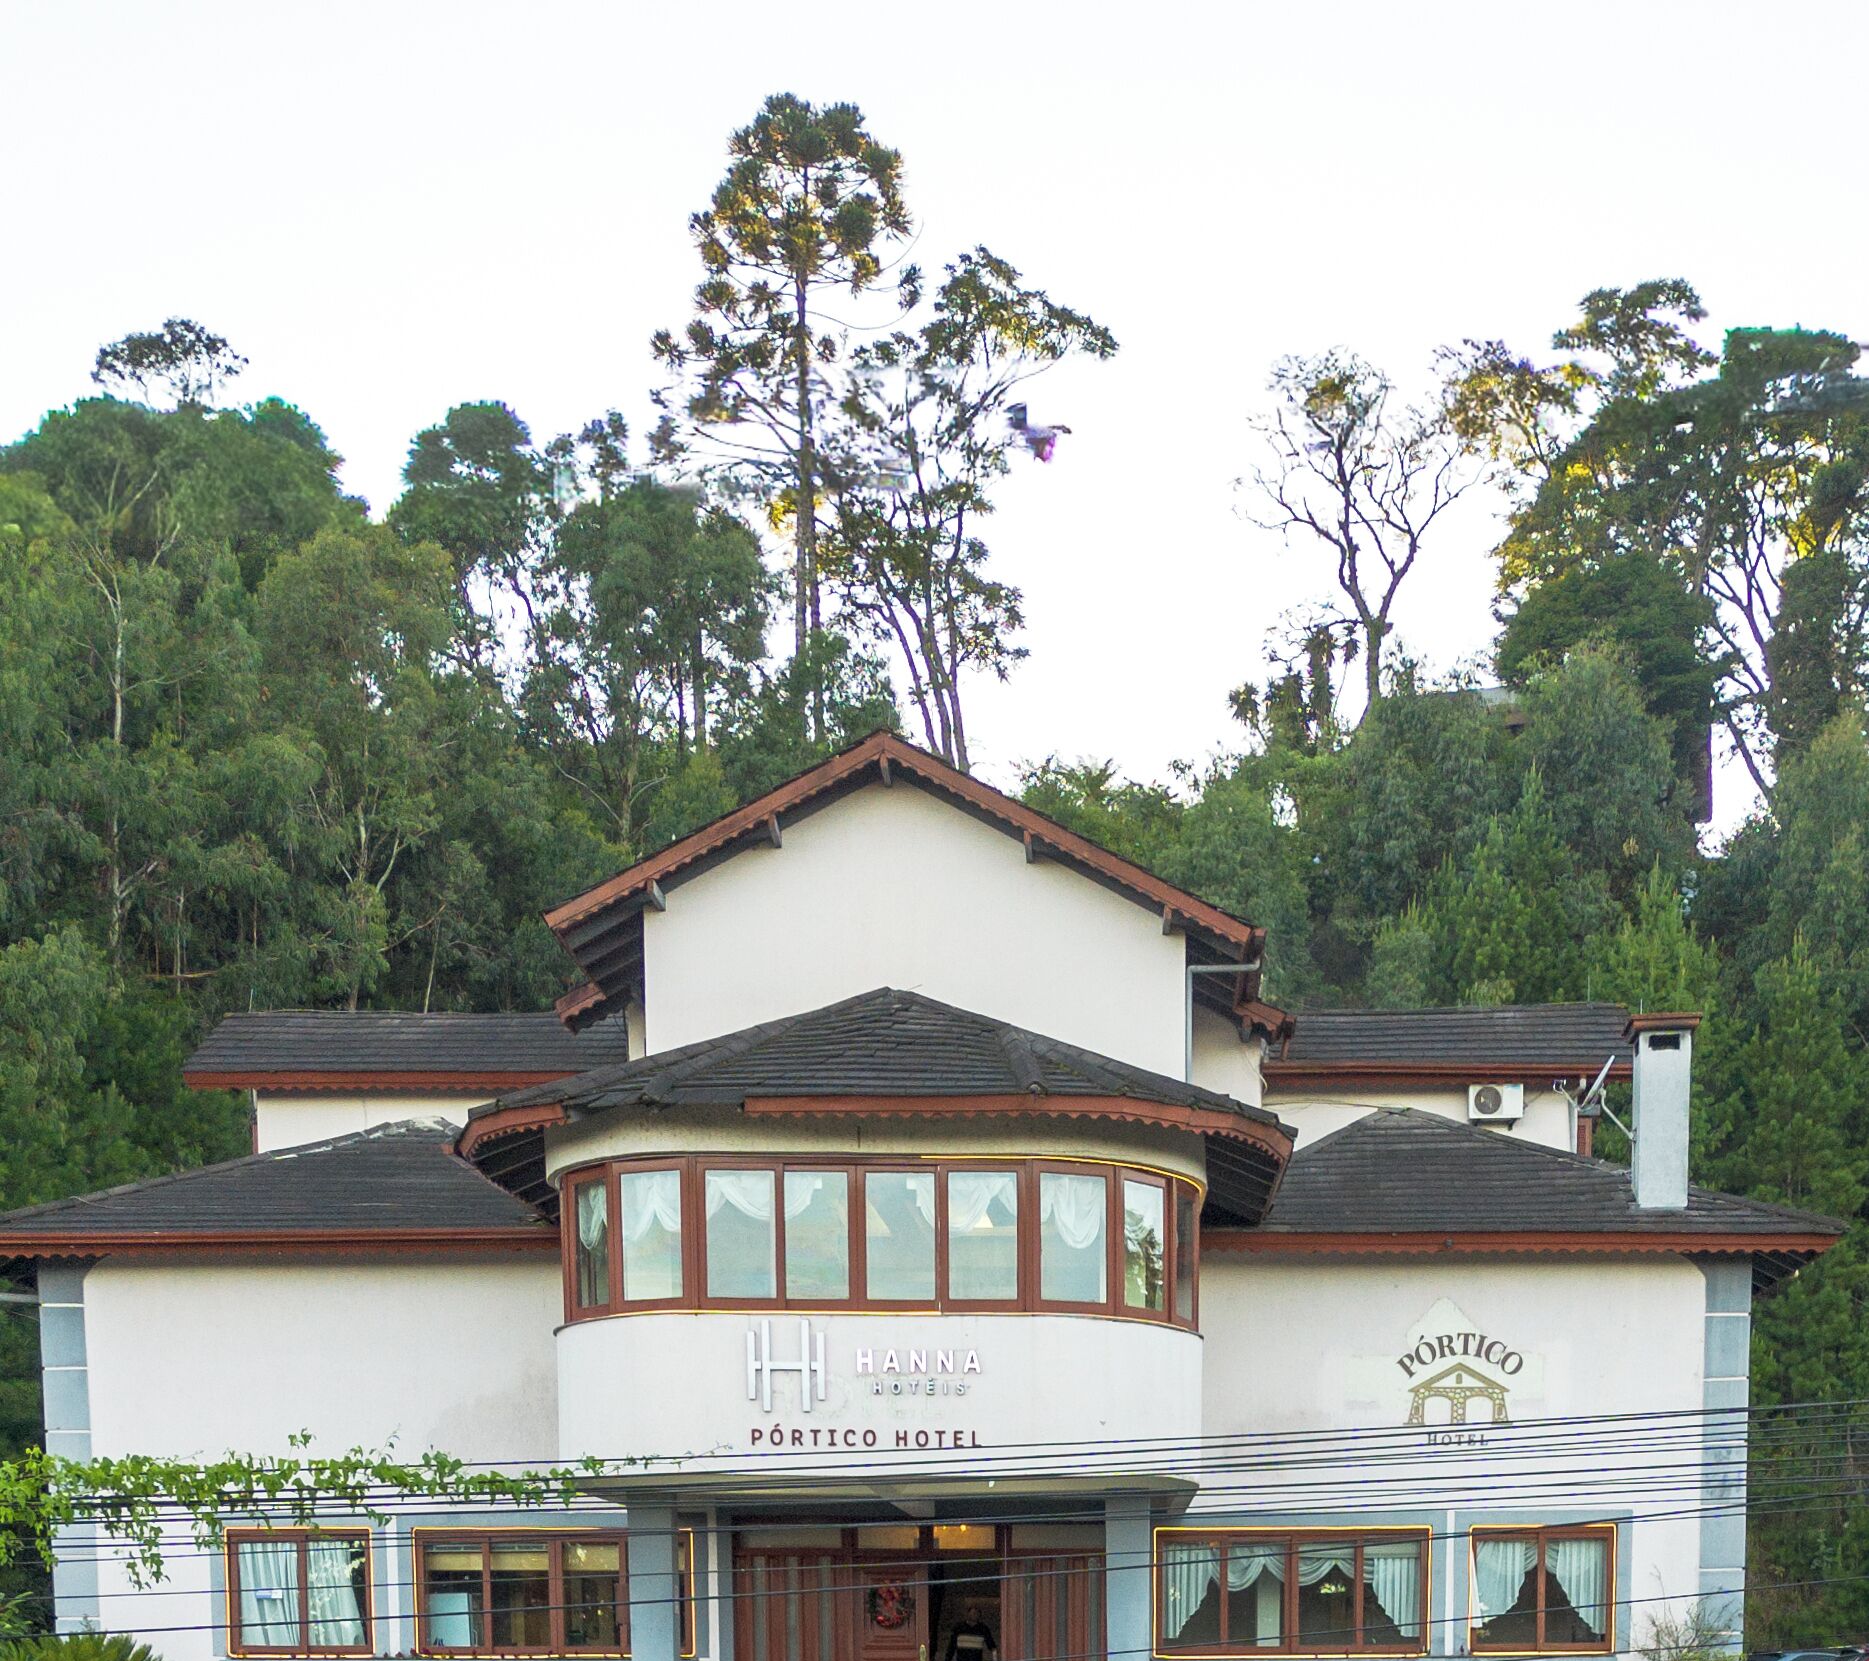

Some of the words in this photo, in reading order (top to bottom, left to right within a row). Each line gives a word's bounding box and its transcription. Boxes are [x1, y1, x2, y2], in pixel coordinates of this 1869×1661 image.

[856, 1348, 981, 1374] HANNA
[1396, 1332, 1524, 1379] PÓRTICO
[873, 1378, 966, 1396] HOTÉIS
[751, 1423, 877, 1447] PÓRTICO
[895, 1430, 982, 1448] HOTEL
[1427, 1433, 1488, 1446] HOTEL
